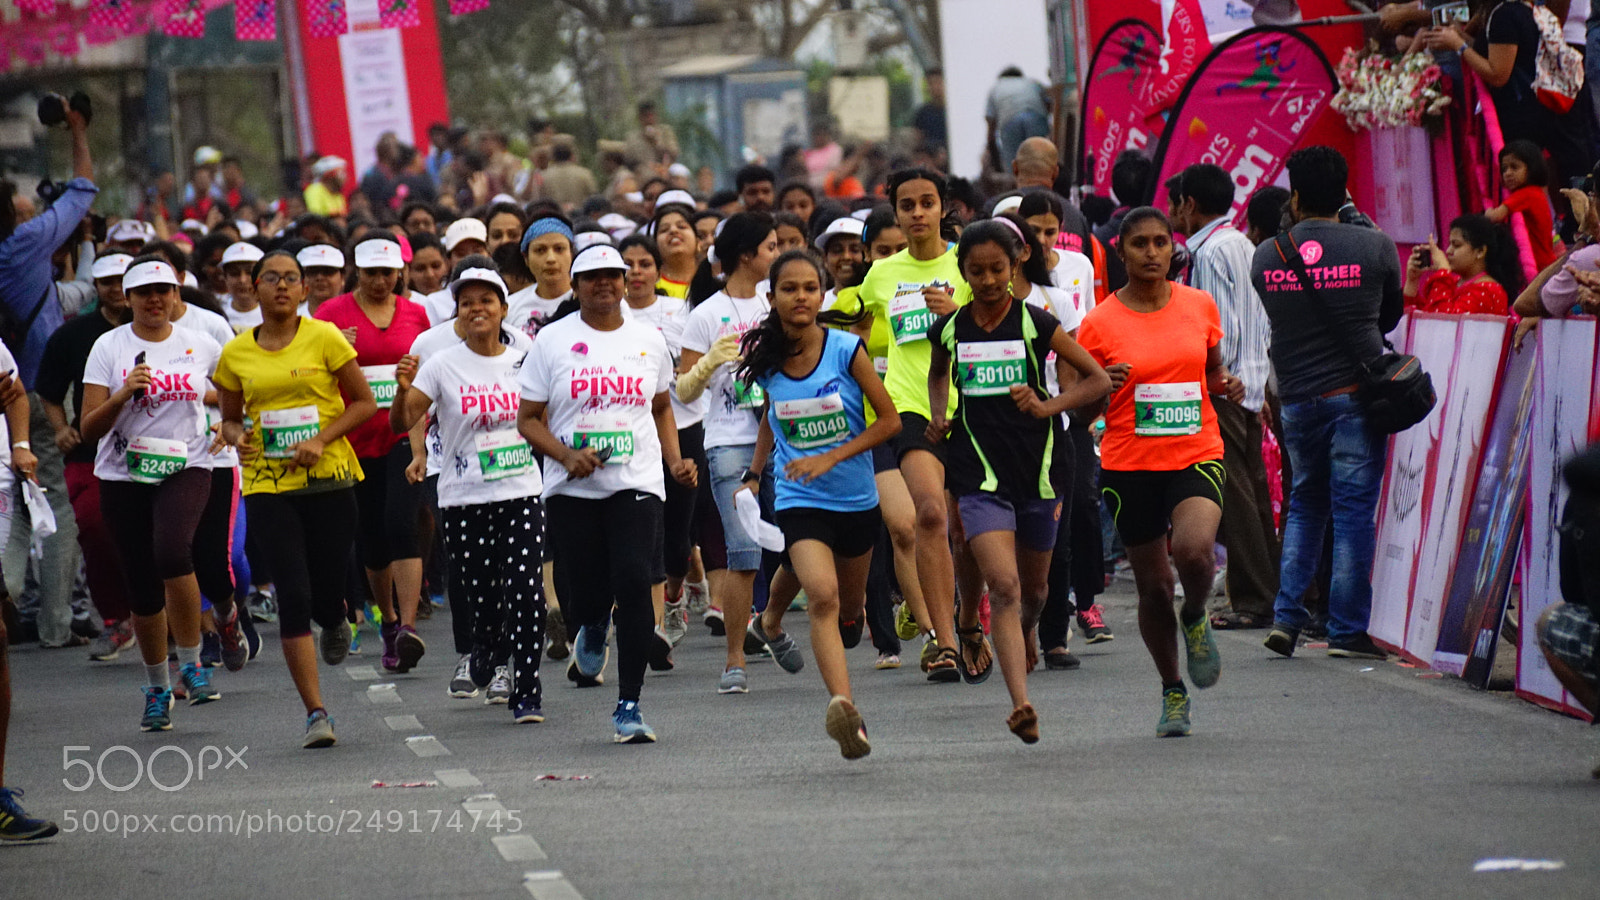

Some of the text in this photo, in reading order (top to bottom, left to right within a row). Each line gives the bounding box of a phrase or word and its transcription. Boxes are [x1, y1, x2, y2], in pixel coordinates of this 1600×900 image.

[1096, 119, 1120, 183] colors
[1263, 264, 1361, 283] TOGTHER
[1266, 284, 1278, 292] WE
[1281, 283, 1303, 291] WILL
[571, 365, 618, 377] I AM A
[976, 365, 1023, 383] 50101
[468, 384, 488, 393] AM
[493, 383, 501, 391] A
[570, 376, 644, 400] PINK
[159, 392, 198, 402] SISTER
[498, 412, 516, 422] SIS
[1155, 406, 1200, 423] 50096
[798, 416, 846, 438] 50040
[589, 435, 632, 452] 50103
[497, 447, 531, 468] 50050
